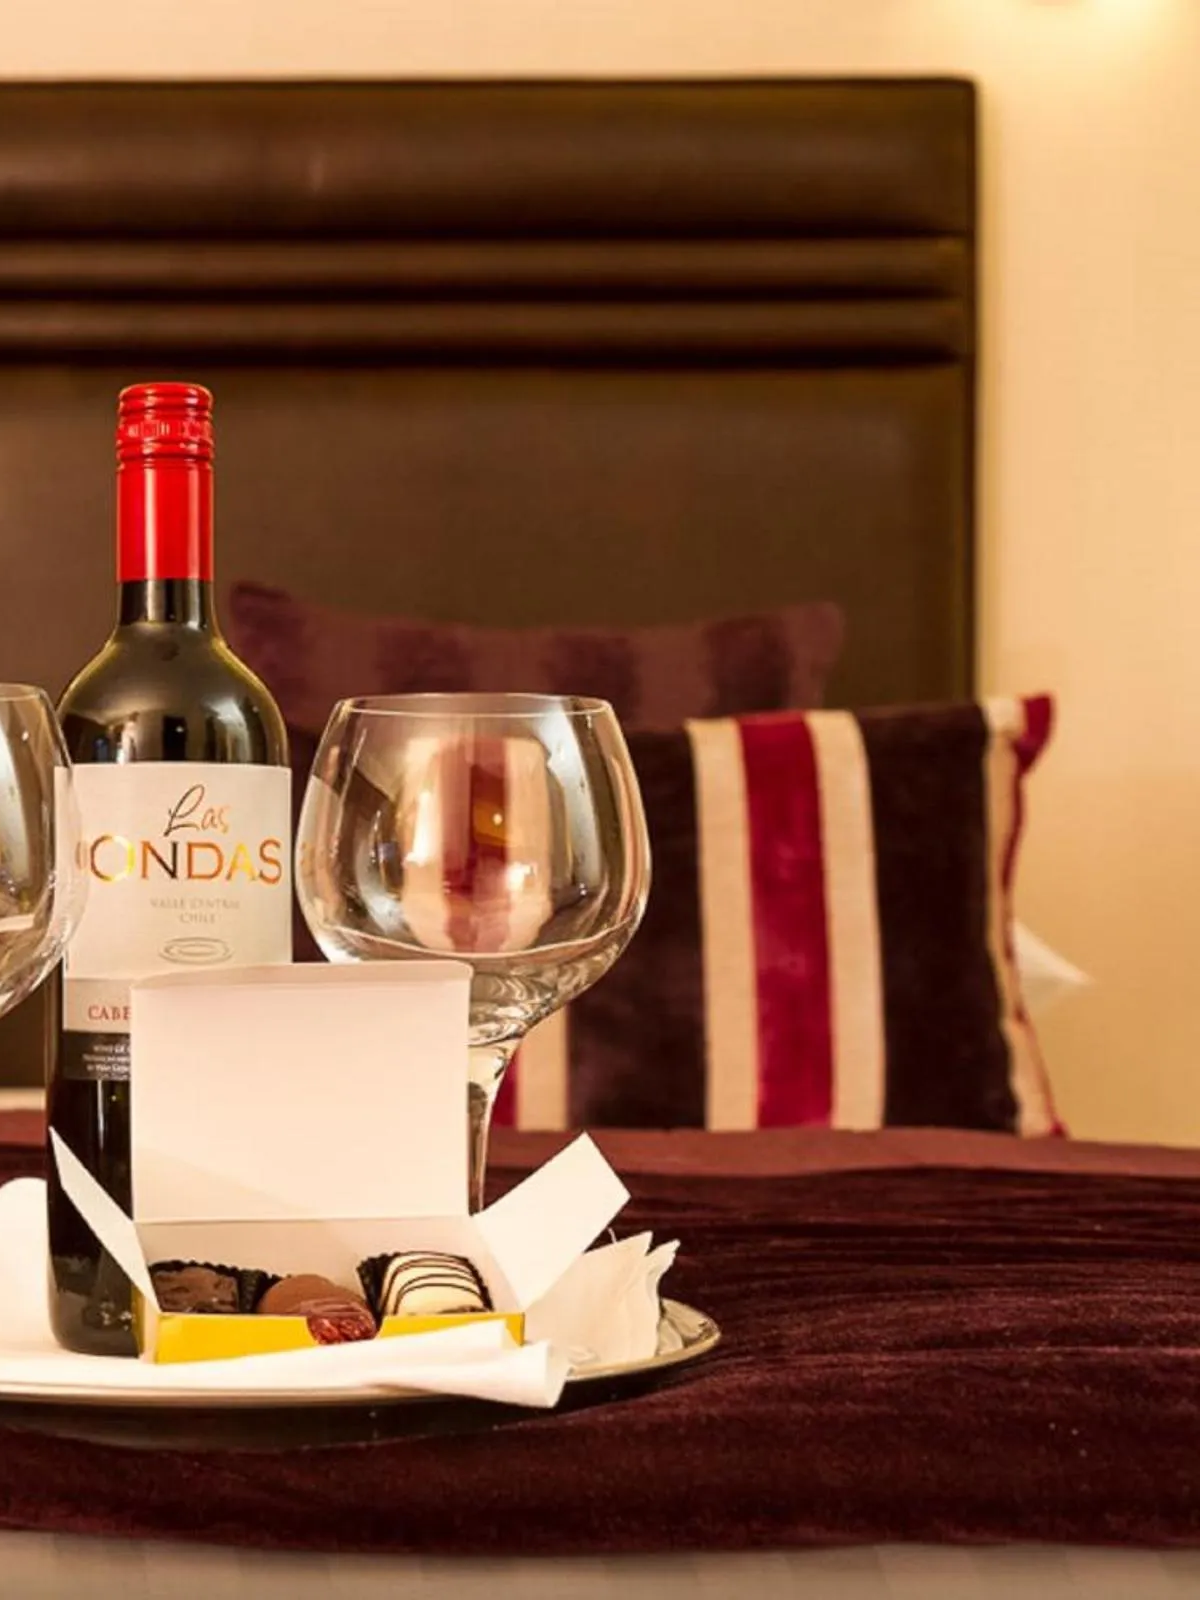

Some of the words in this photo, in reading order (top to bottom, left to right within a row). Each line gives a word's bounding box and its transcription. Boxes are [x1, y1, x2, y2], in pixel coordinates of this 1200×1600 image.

[163, 784, 230, 837] Las
[90, 835, 282, 884] ONDAS
[180, 912, 216, 923] CHILE
